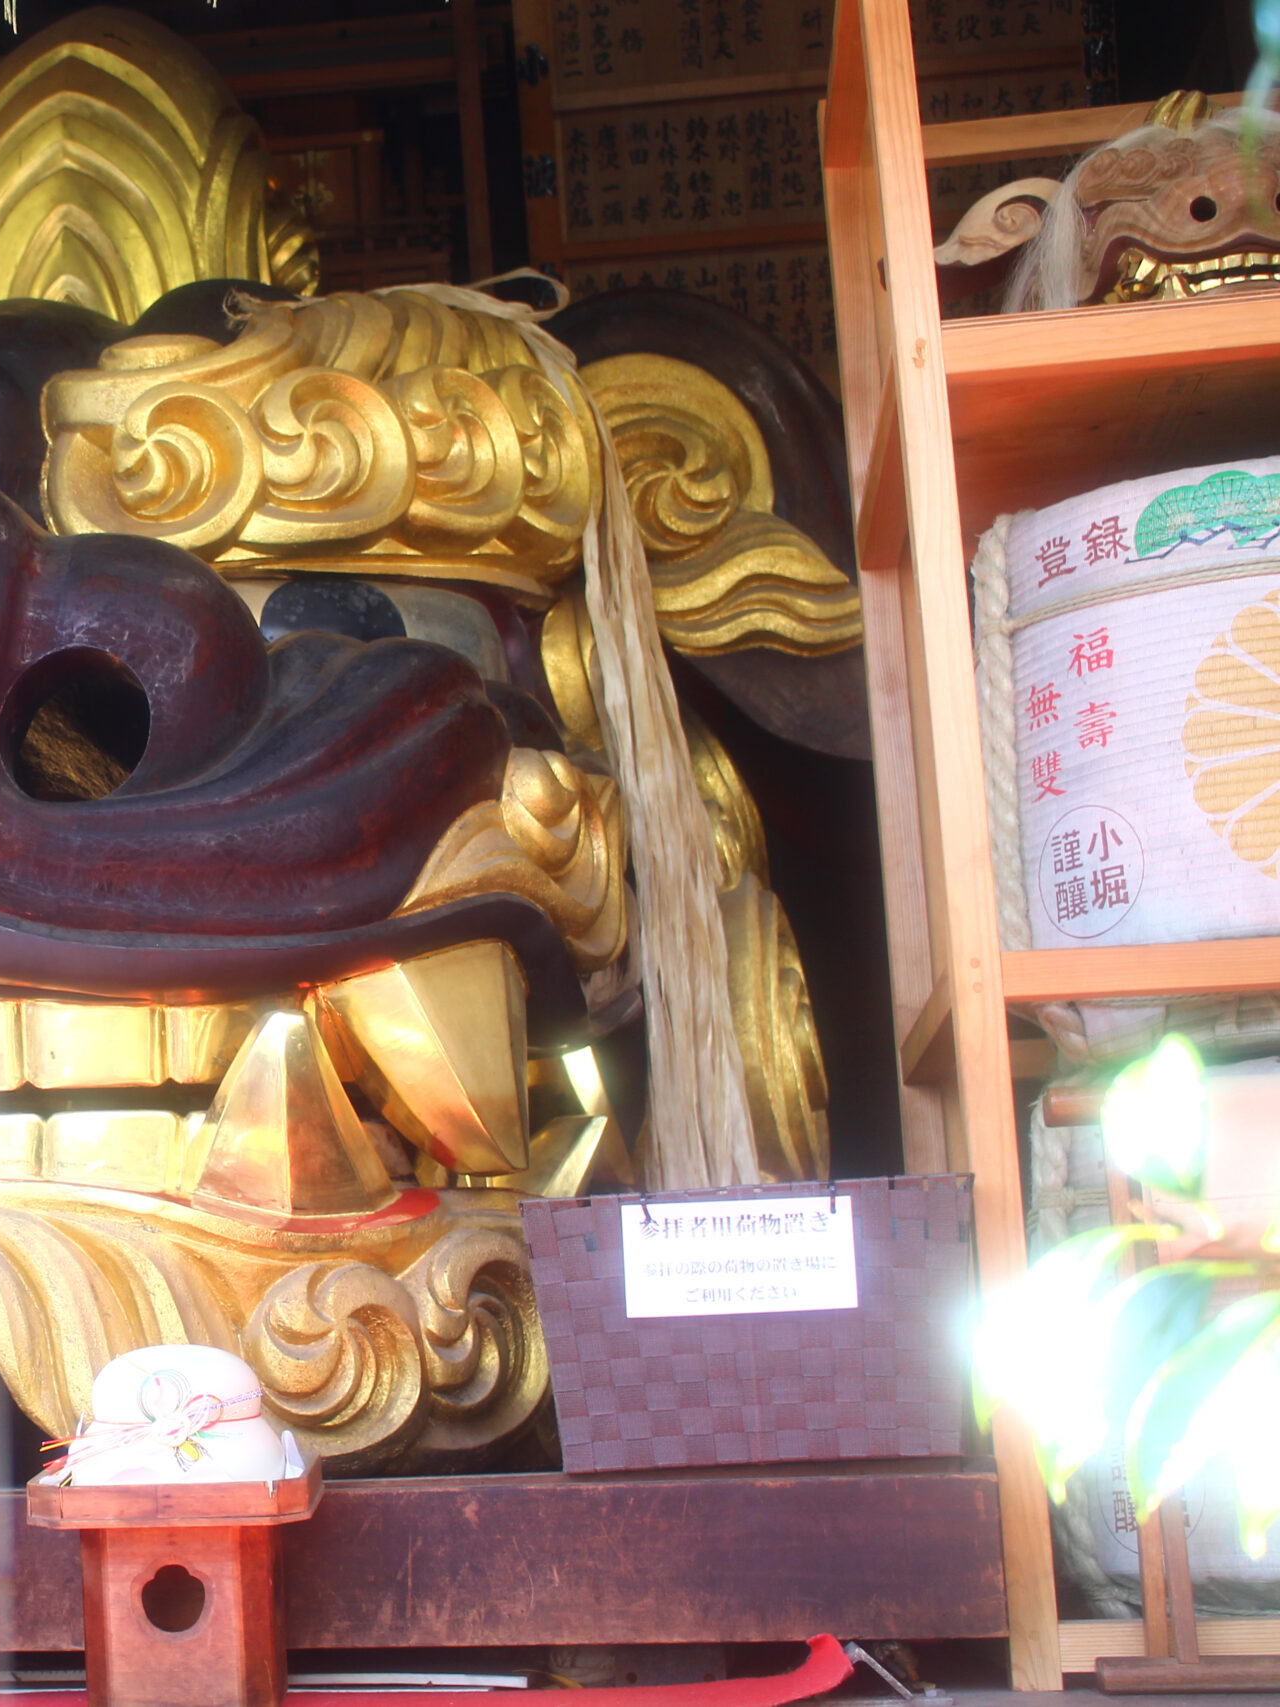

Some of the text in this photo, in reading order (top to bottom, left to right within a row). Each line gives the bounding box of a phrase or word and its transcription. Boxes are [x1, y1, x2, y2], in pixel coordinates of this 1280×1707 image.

[1034, 514, 1131, 589] 登録
[1087, 820, 1129, 910] 小堀
[685, 1286, 798, 1304] ご利用ください
